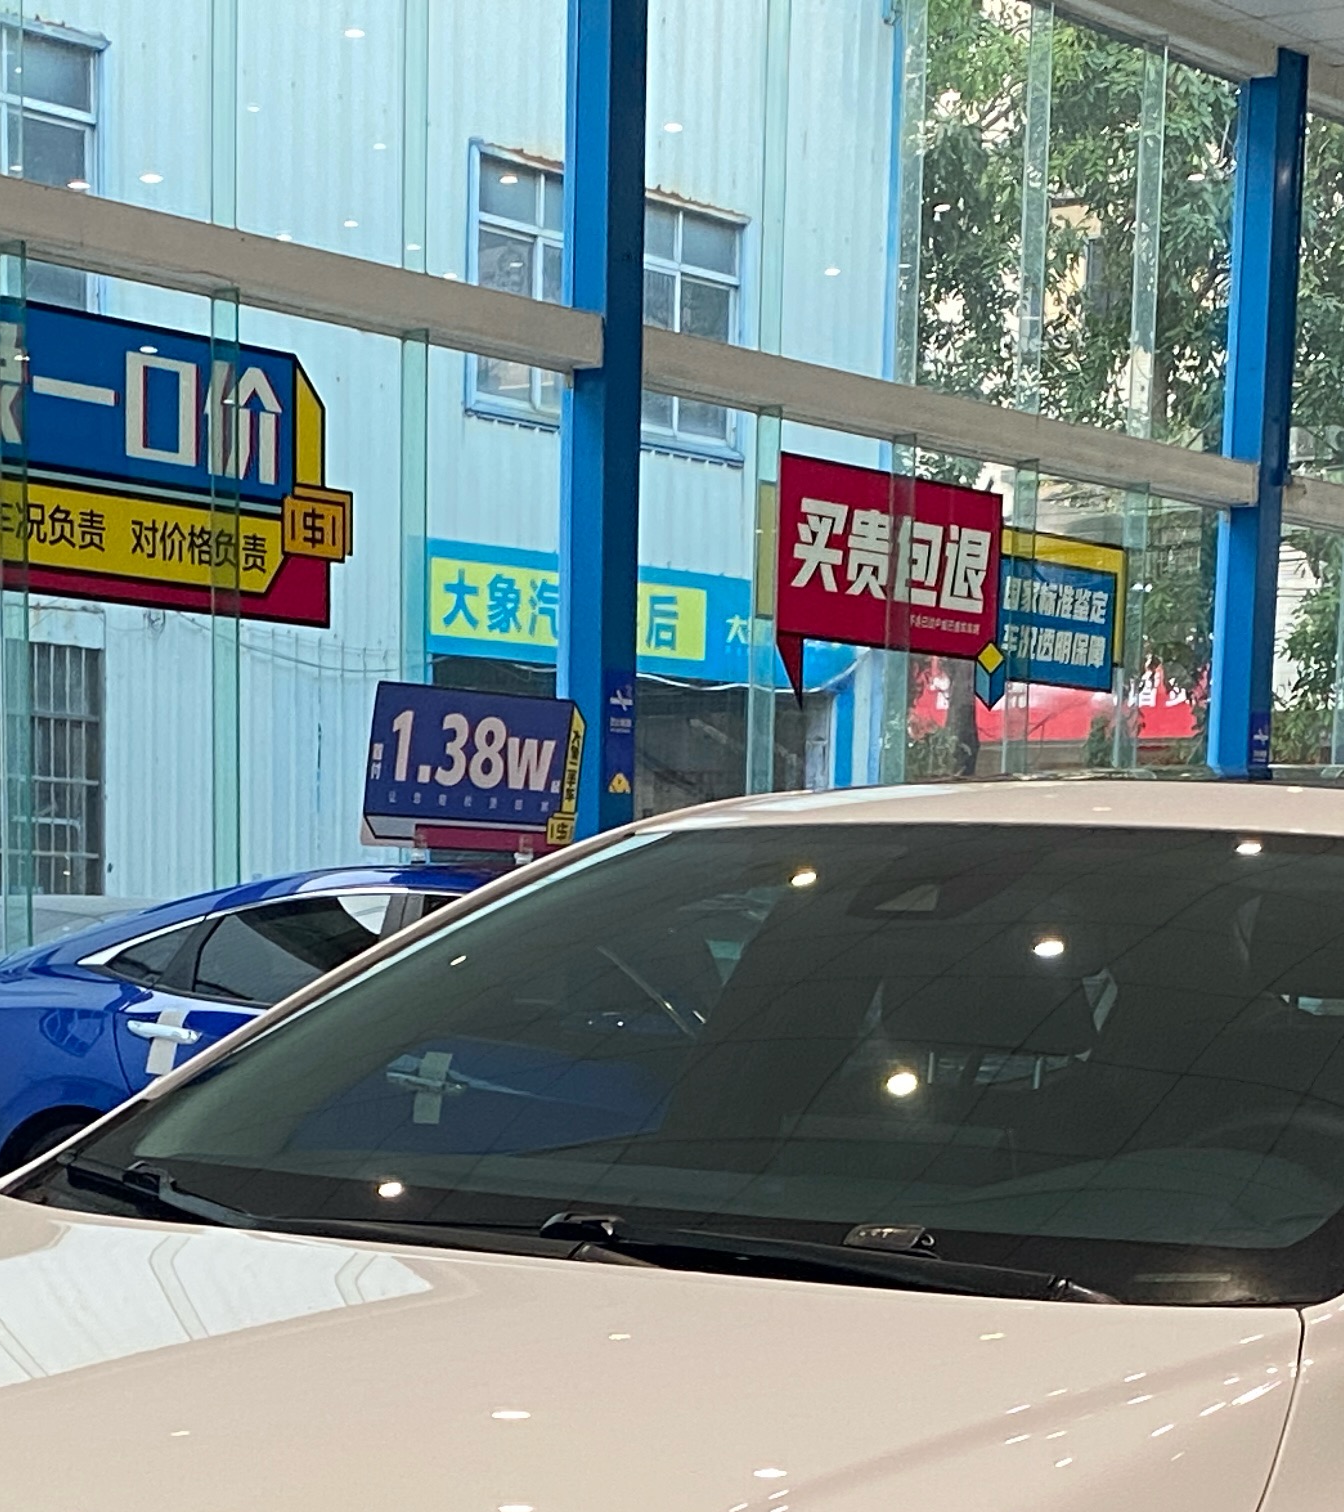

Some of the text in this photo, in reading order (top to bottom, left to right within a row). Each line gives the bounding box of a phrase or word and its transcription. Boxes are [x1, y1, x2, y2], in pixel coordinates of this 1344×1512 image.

[131, 520, 267, 575] 对价格负责
[790, 497, 991, 614] 买贵包退
[442, 569, 678, 651] 大象汽后
